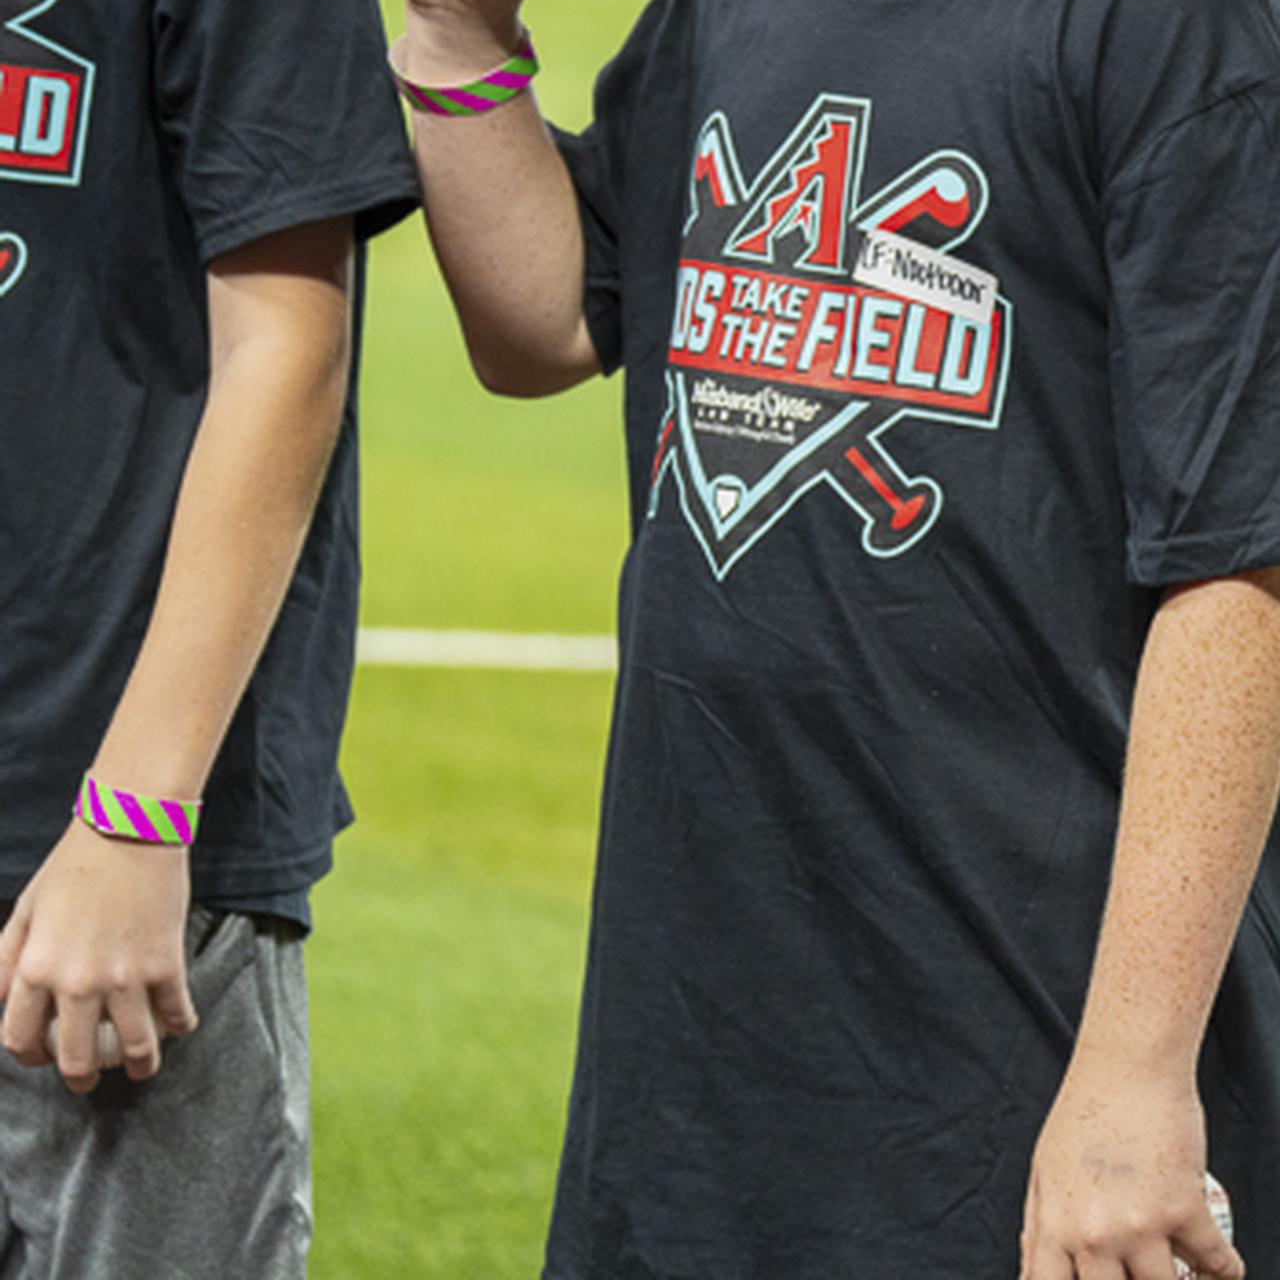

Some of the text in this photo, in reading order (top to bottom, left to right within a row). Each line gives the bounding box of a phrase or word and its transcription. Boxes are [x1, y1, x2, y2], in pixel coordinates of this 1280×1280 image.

[719, 313, 797, 366] THE
[730, 275, 810, 320] TAKE
[796, 288, 993, 396] FIELD
